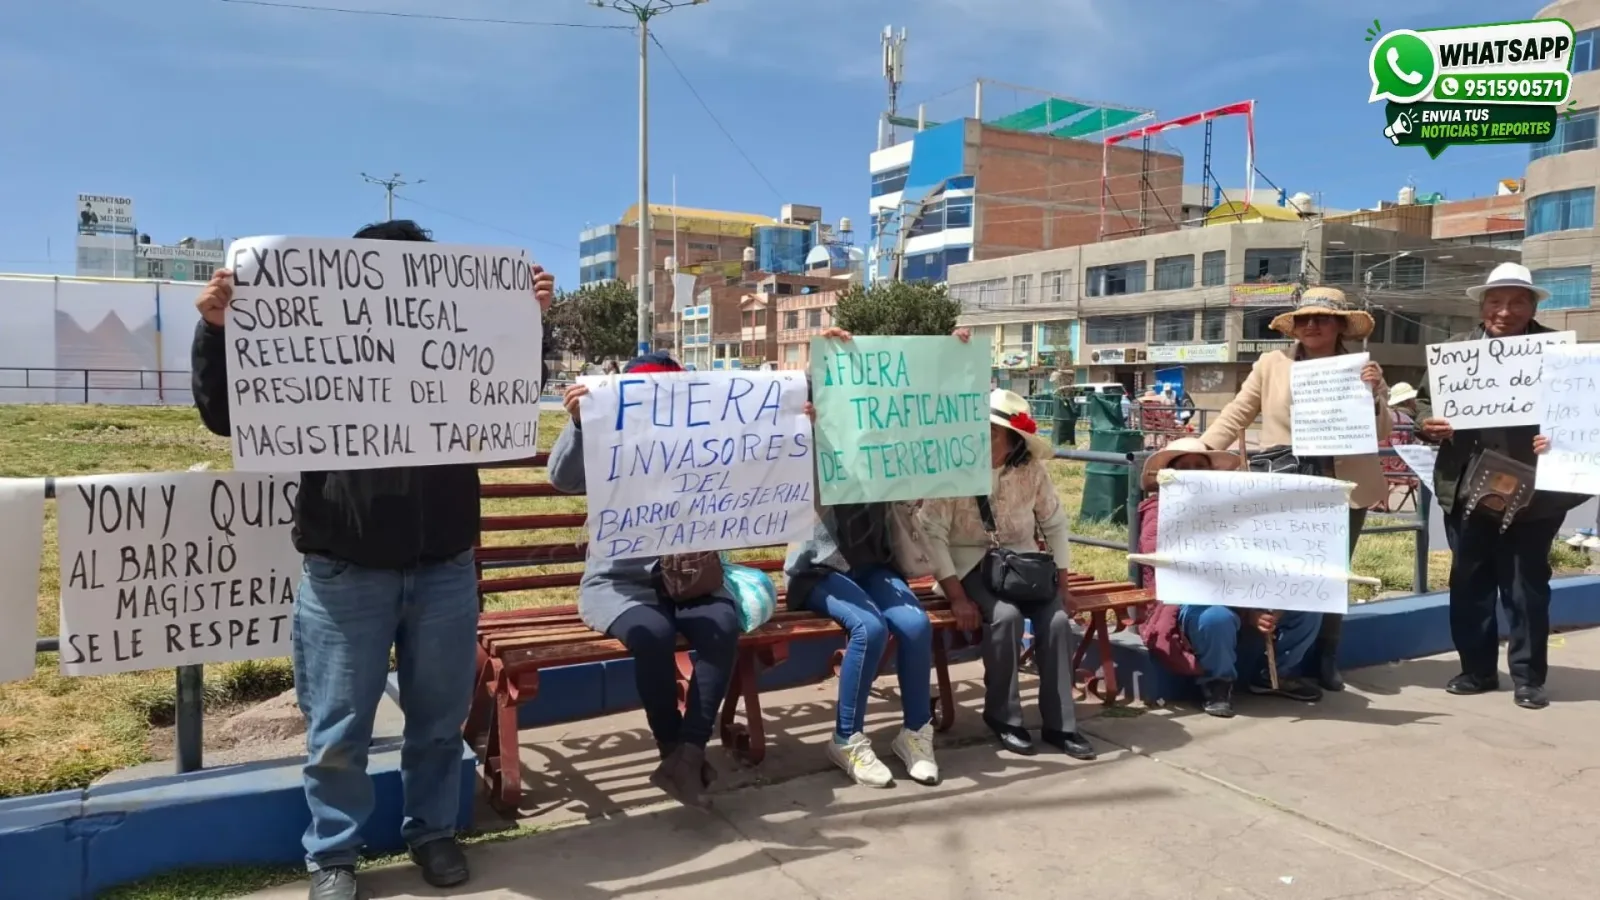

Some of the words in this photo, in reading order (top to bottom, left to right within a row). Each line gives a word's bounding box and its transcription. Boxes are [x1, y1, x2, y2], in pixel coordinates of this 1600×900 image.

[79, 194, 132, 205] LICENCIADO
[233, 247, 384, 290] EXIGIMOS
[230, 296, 323, 331] SOBRE
[343, 297, 372, 325] LA
[385, 296, 468, 332] ILEGAL
[235, 328, 396, 370] REELECCIÓN
[422, 339, 495, 376] COMO
[824, 350, 910, 388] ¡FUERA
[235, 375, 393, 406] PRESIDENTE
[411, 379, 449, 404] DEL
[470, 378, 540, 406] BARRIO
[1438, 374, 1500, 395] Fuera
[850, 393, 991, 430] TRAFICANTES
[1443, 396, 1536, 418] Barrio
[236, 423, 416, 458] MAGISTERIAL
[430, 420, 538, 454] TAPARACHI
[606, 433, 808, 482] INVASORES
[820, 451, 848, 482] DE
[670, 470, 732, 494] DEL
[596, 500, 682, 542] BARRIO
[687, 481, 811, 518] MAGISTERIAL
[1252, 519, 1282, 532] DEL
[1289, 519, 1347, 537] BARRIO
[654, 510, 789, 550] TAPARACHI
[1163, 534, 1292, 554] MAGISTERIAL
[1301, 538, 1328, 554] DE
[69, 549, 105, 590] AL
[116, 535, 237, 584] BARRIO
